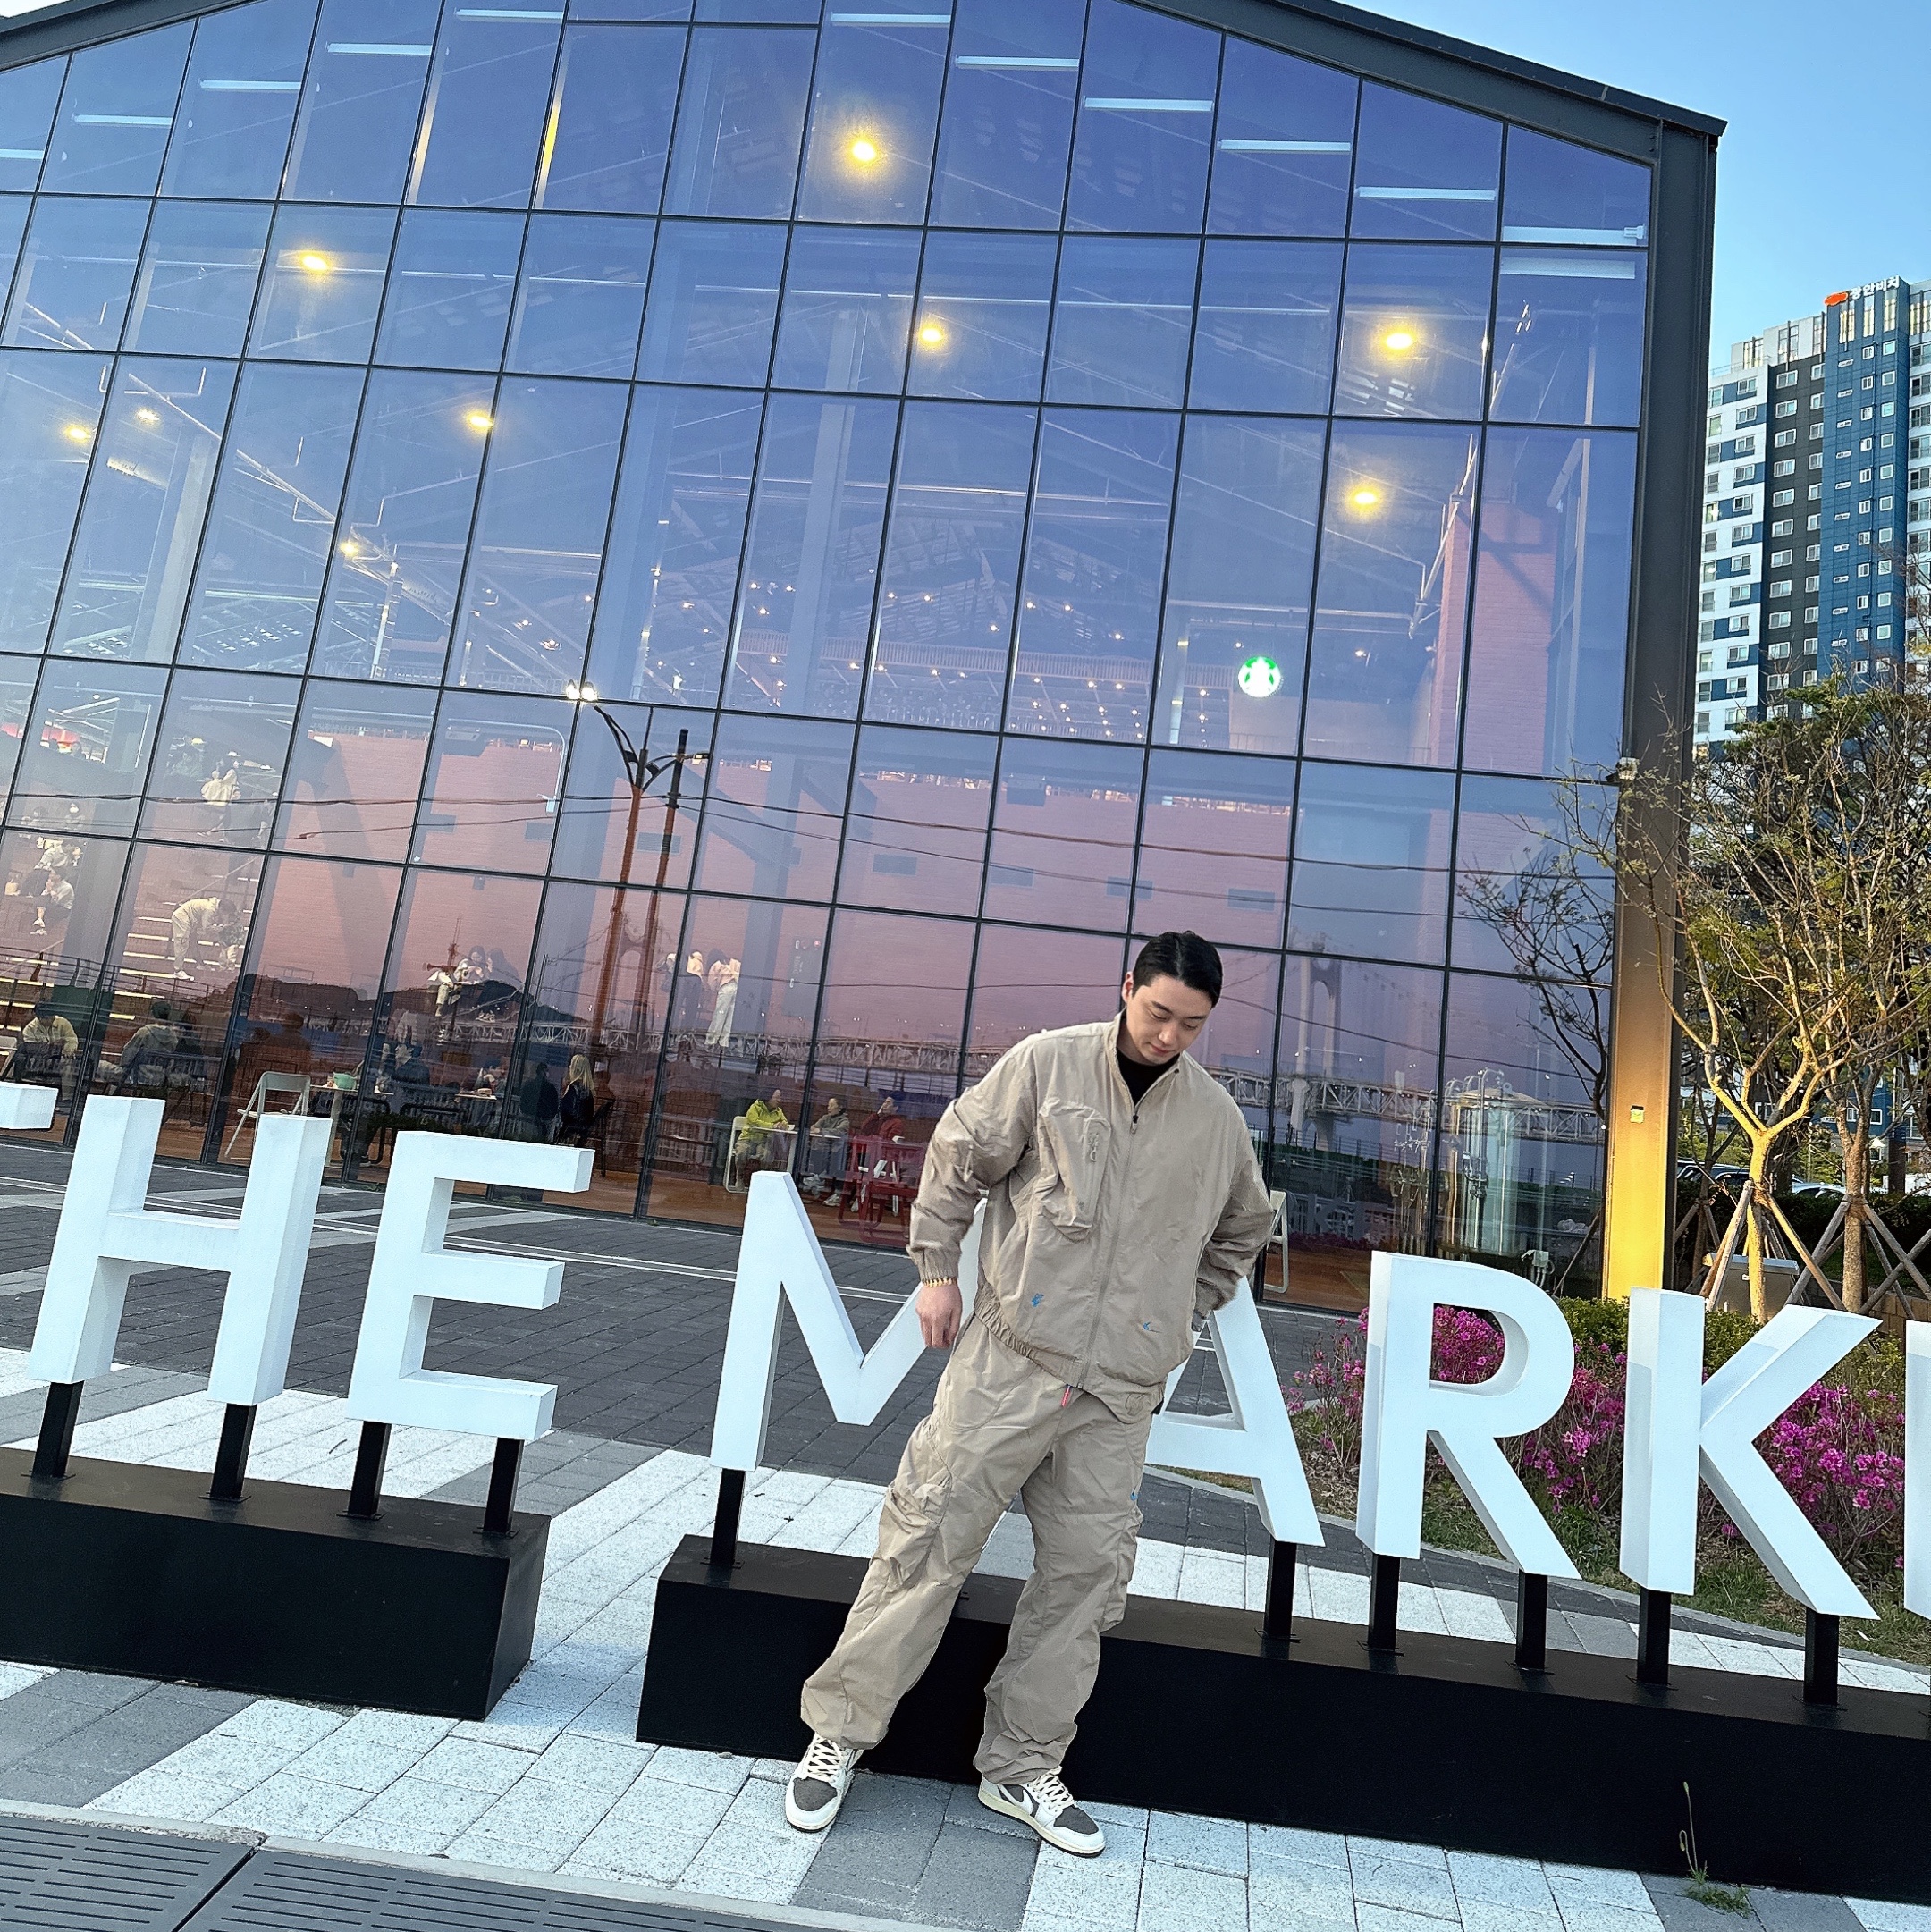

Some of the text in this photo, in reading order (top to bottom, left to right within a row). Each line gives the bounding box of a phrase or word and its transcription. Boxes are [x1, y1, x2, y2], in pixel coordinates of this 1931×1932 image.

[1849, 274, 1900, 300] 광안비치
[0, 1082, 1931, 1621] HE MARK
